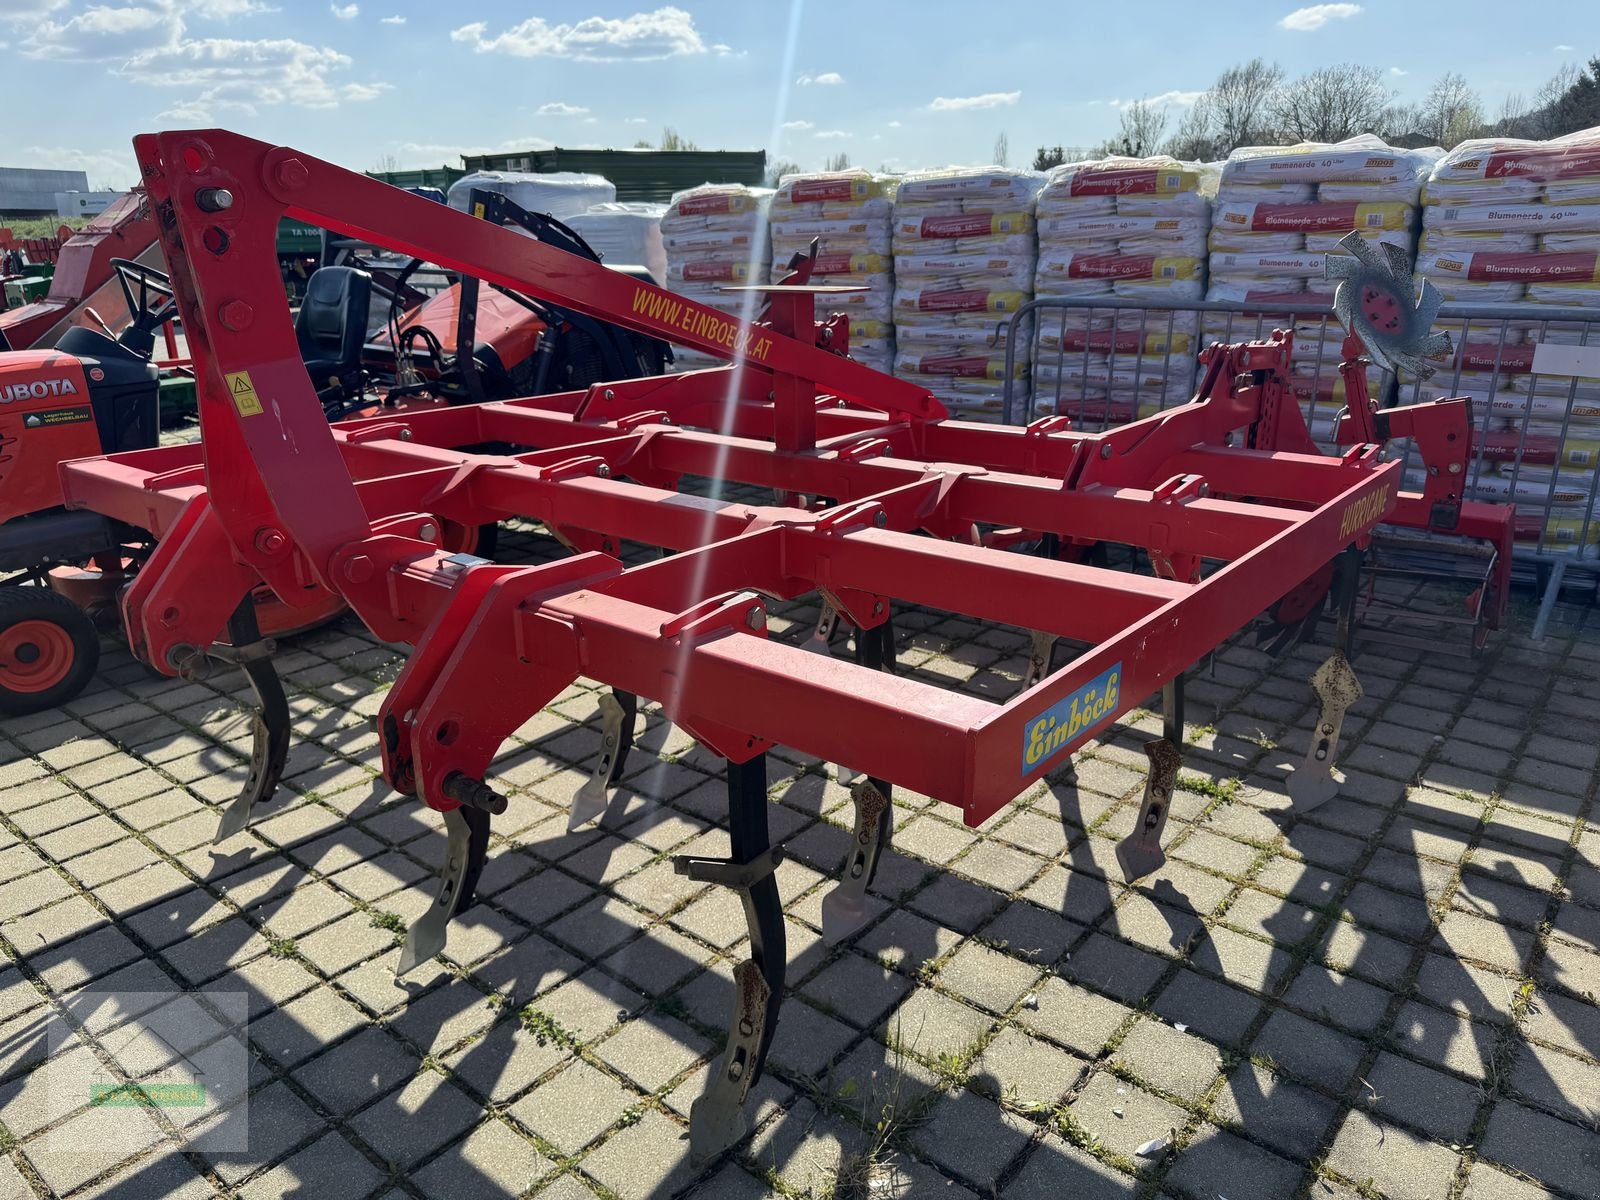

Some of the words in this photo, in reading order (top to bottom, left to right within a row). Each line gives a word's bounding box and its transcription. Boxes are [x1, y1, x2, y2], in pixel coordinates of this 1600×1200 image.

[1270, 160, 1315, 169] Blumenerde
[1487, 211, 1543, 220] Blumenerde
[1550, 212, 1563, 220] 40
[1265, 216, 1311, 225] Blumenerde
[1259, 259, 1303, 267] Blumenerde
[1486, 264, 1541, 274] Blumenerde
[1548, 266, 1561, 274] 40
[632, 287, 773, 361] WWW.EINBOECK.AT
[1338, 483, 1390, 541] HURRICANE
[1026, 672, 1118, 764] Einböck
